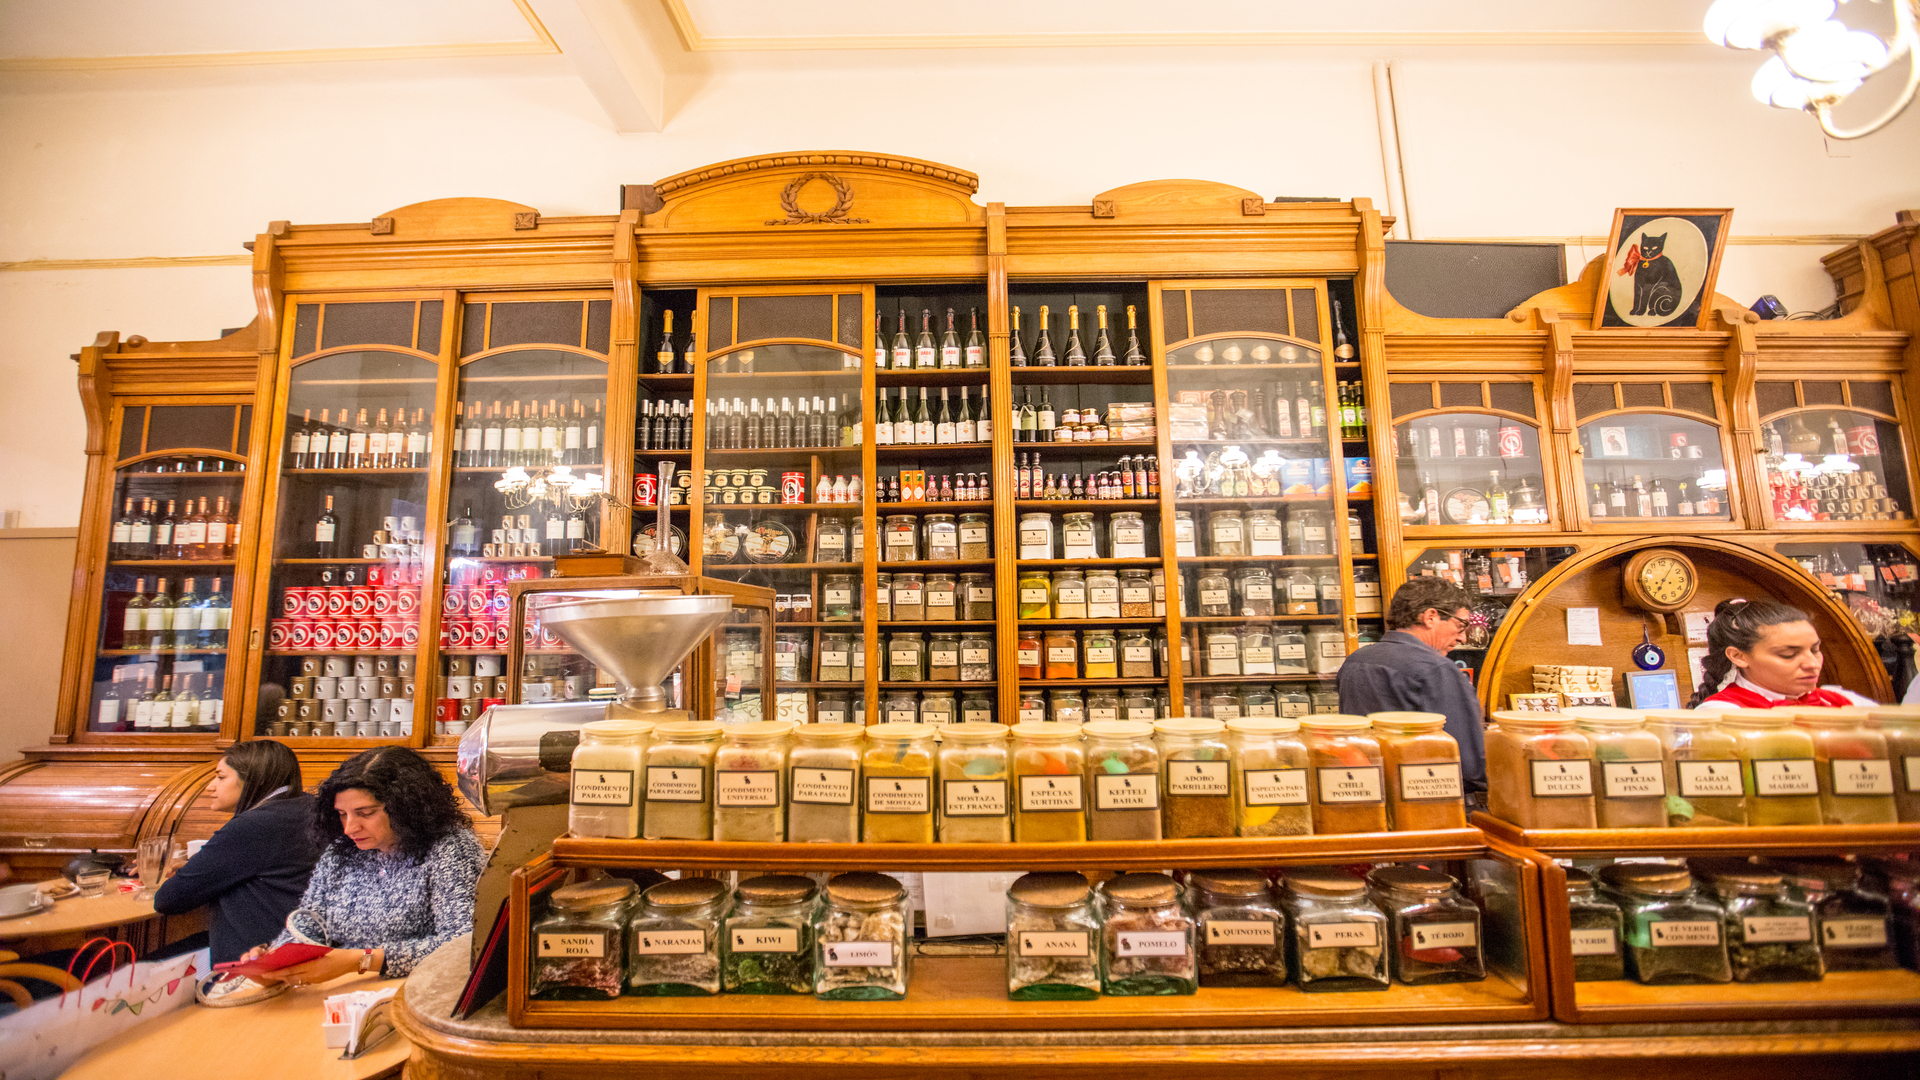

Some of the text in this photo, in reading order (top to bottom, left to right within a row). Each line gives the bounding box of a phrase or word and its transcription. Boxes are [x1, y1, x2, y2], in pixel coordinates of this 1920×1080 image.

[1408, 777, 1455, 785] CONDIMENTO
[1543, 774, 1584, 783] ESPECIAS
[1614, 776, 1656, 784] ESPECIAS
[1695, 774, 1730, 783] GARAM
[1772, 774, 1803, 782] CURRY
[1849, 773, 1880, 781] CURRY
[576, 784, 629, 793] CONDIMENTO
[796, 783, 848, 791] CONDIMENTO
[1172, 783, 1226, 791] PARRILLERO
[1547, 783, 1581, 791] DULCES
[1332, 790, 1371, 798] POWDER
[1223, 929, 1271, 937] QUINOTOS
[1431, 931, 1442, 940] TÉ
[560, 936, 595, 945] SANDÍA
[1044, 939, 1077, 949] ANANÁ
